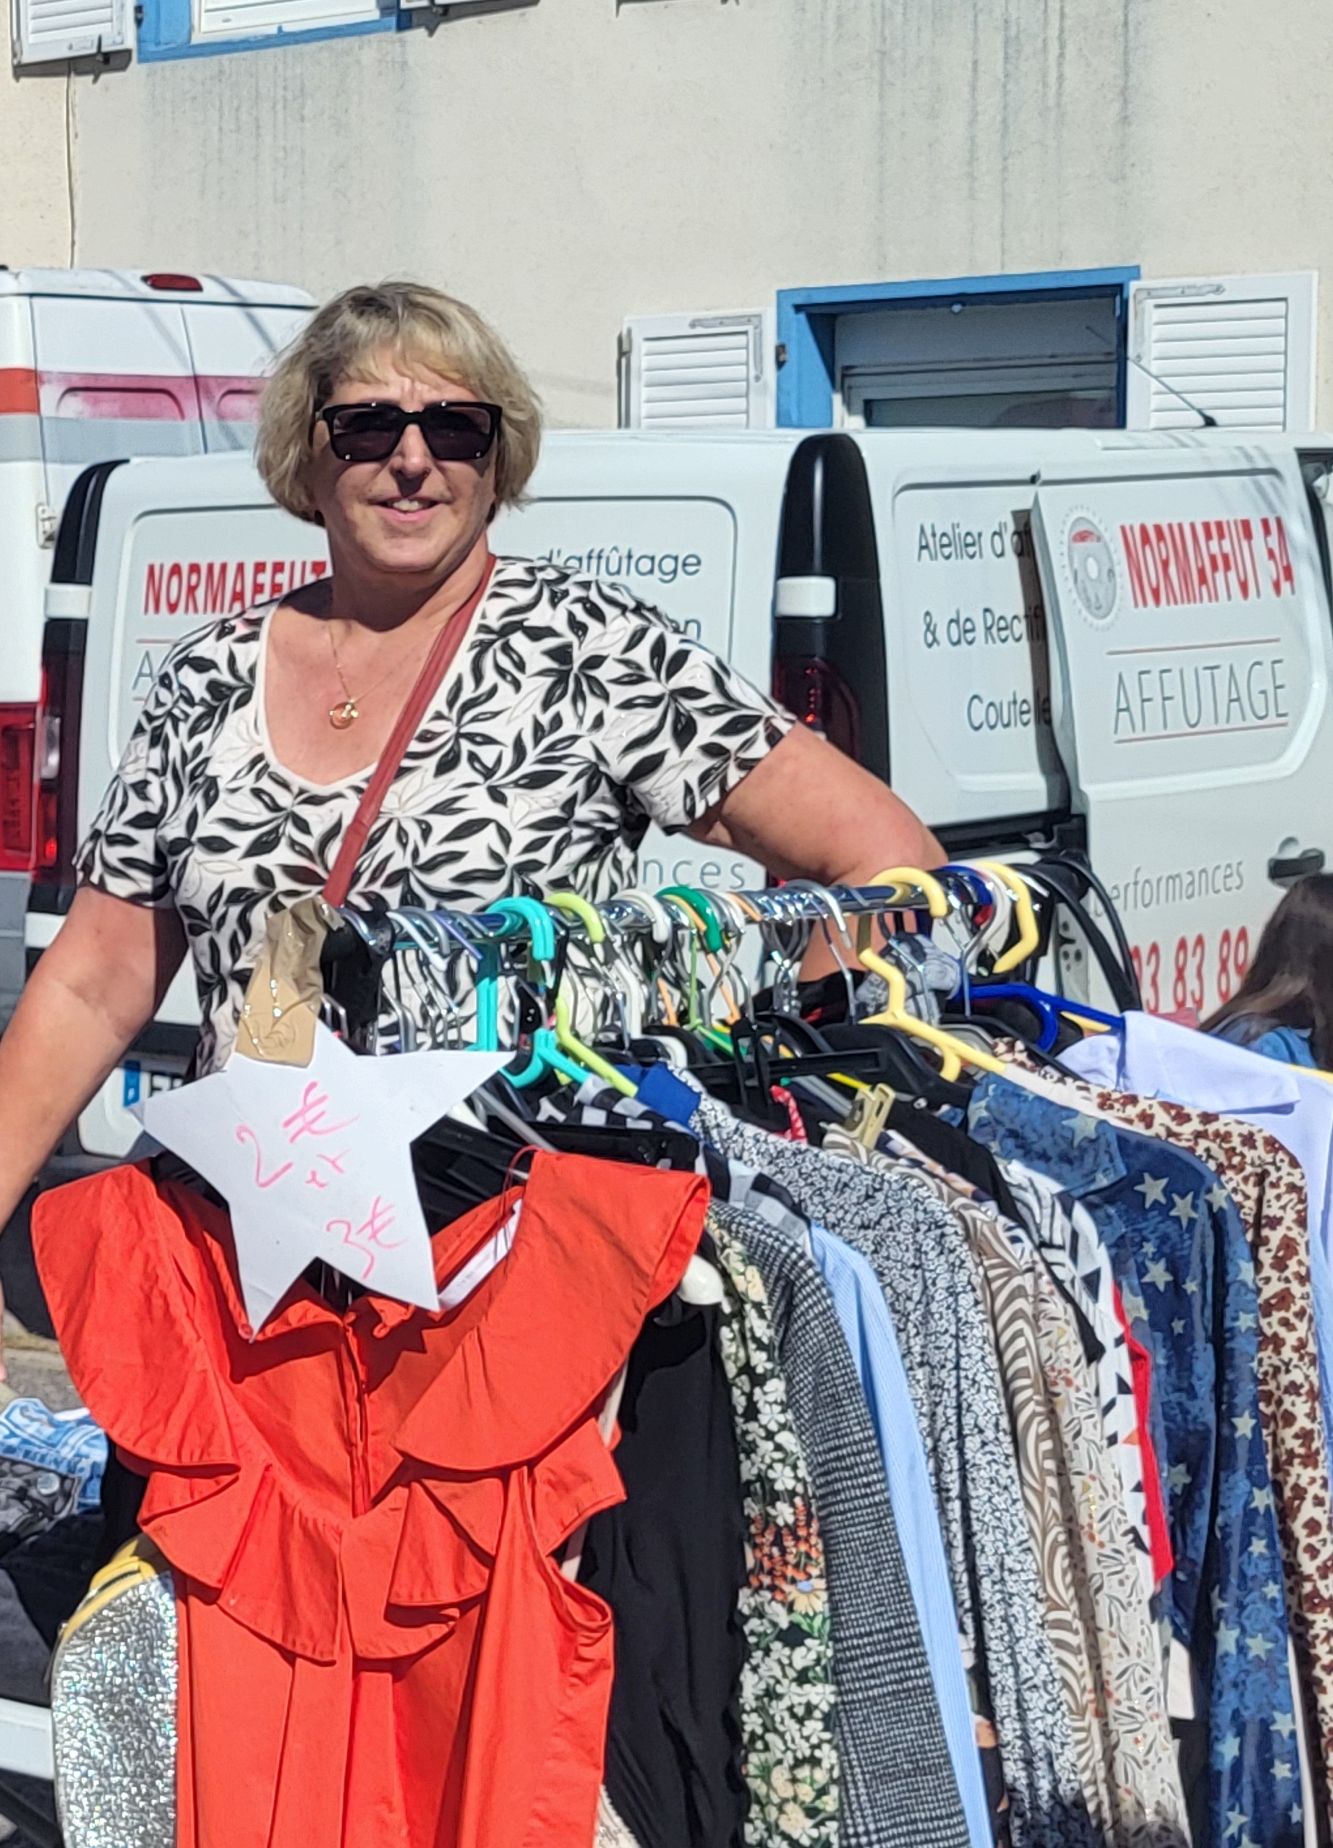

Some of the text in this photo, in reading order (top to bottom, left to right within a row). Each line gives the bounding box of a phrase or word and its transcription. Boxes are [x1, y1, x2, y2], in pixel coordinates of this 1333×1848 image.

[917, 521, 984, 562] Atelier
[1120, 516, 1296, 609] NORMAFFUT 54
[923, 610, 940, 649] &
[946, 608, 976, 647] de
[1113, 658, 1289, 735] AFFUTAGE
[1093, 861, 1244, 917] erformances
[1173, 933, 1205, 1014] 83
